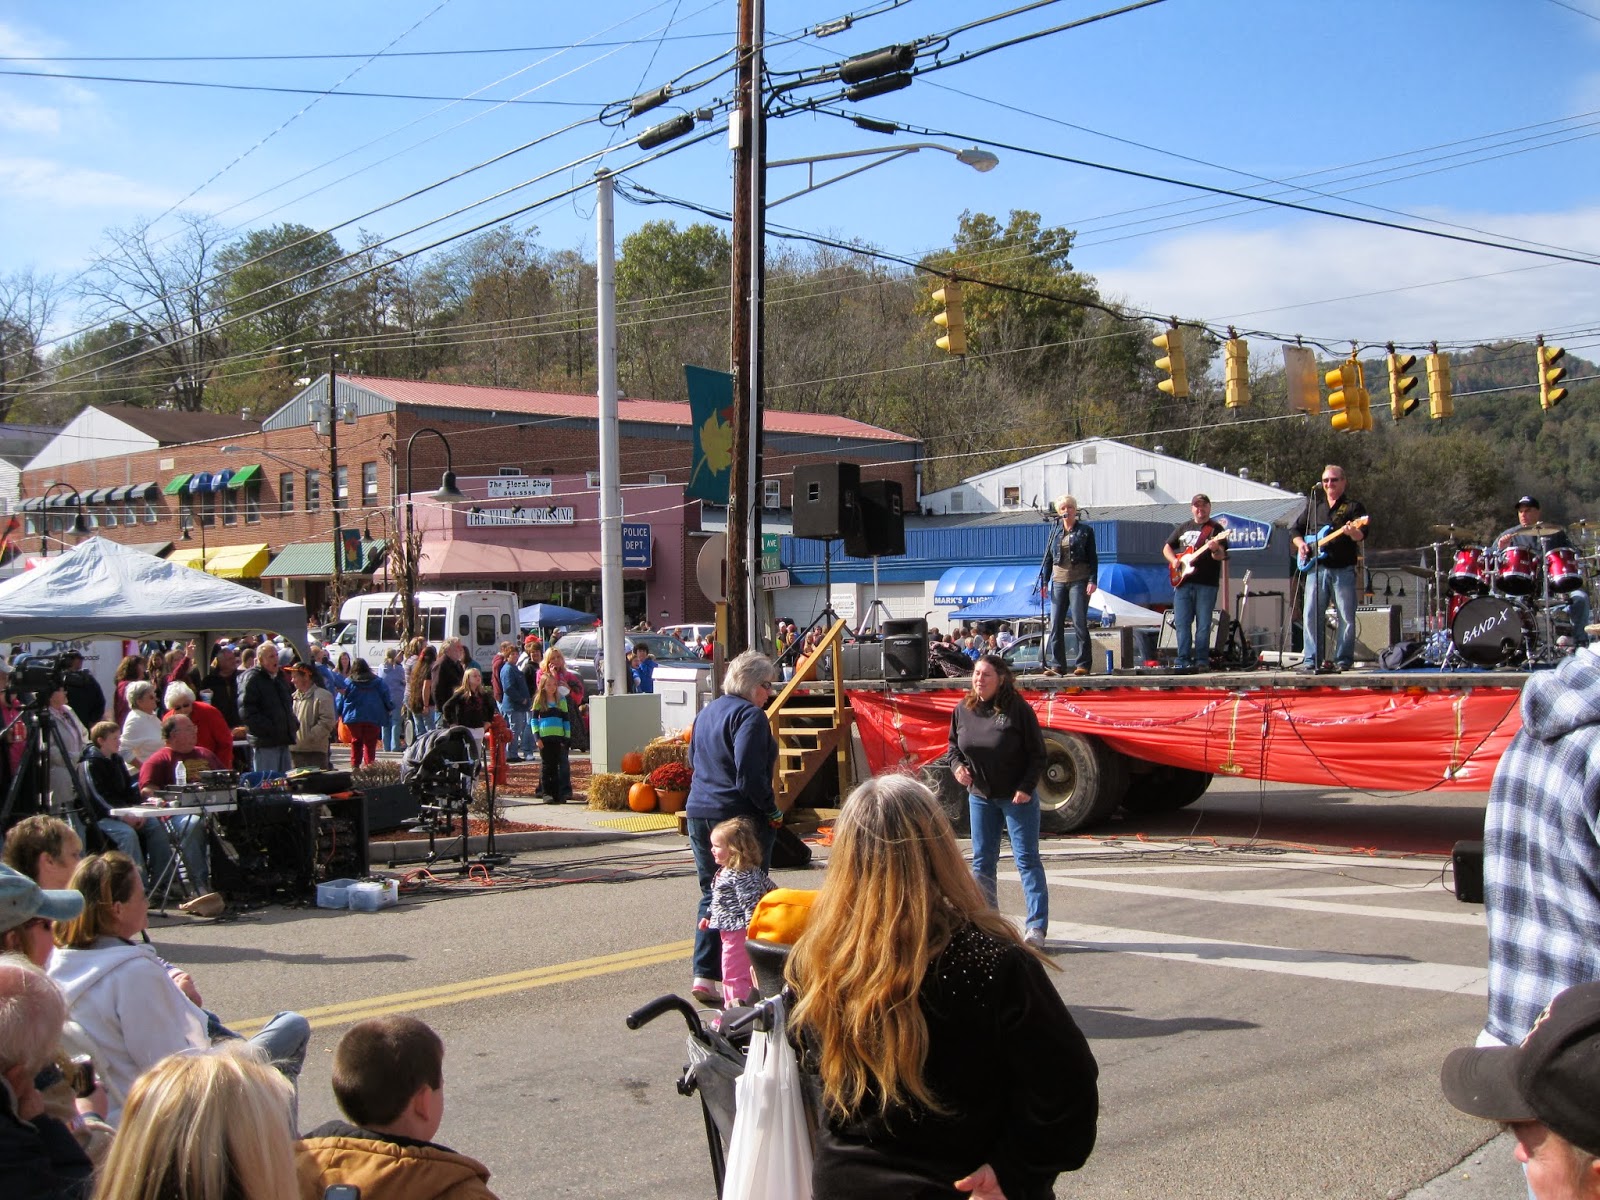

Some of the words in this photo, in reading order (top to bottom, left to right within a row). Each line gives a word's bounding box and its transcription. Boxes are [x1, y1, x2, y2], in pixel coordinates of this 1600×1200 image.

[506, 480, 529, 489] Floral
[532, 479, 551, 488] Shop
[470, 509, 486, 525] THE
[623, 527, 648, 537] POLICE
[1226, 527, 1265, 542] drich
[625, 540, 646, 550] DEPT.
[766, 539, 777, 548] AVE
[761, 556, 770, 570] KY
[934, 596, 963, 604] MARK'S
[1462, 616, 1496, 645] BAND
[1497, 607, 1509, 625] X
